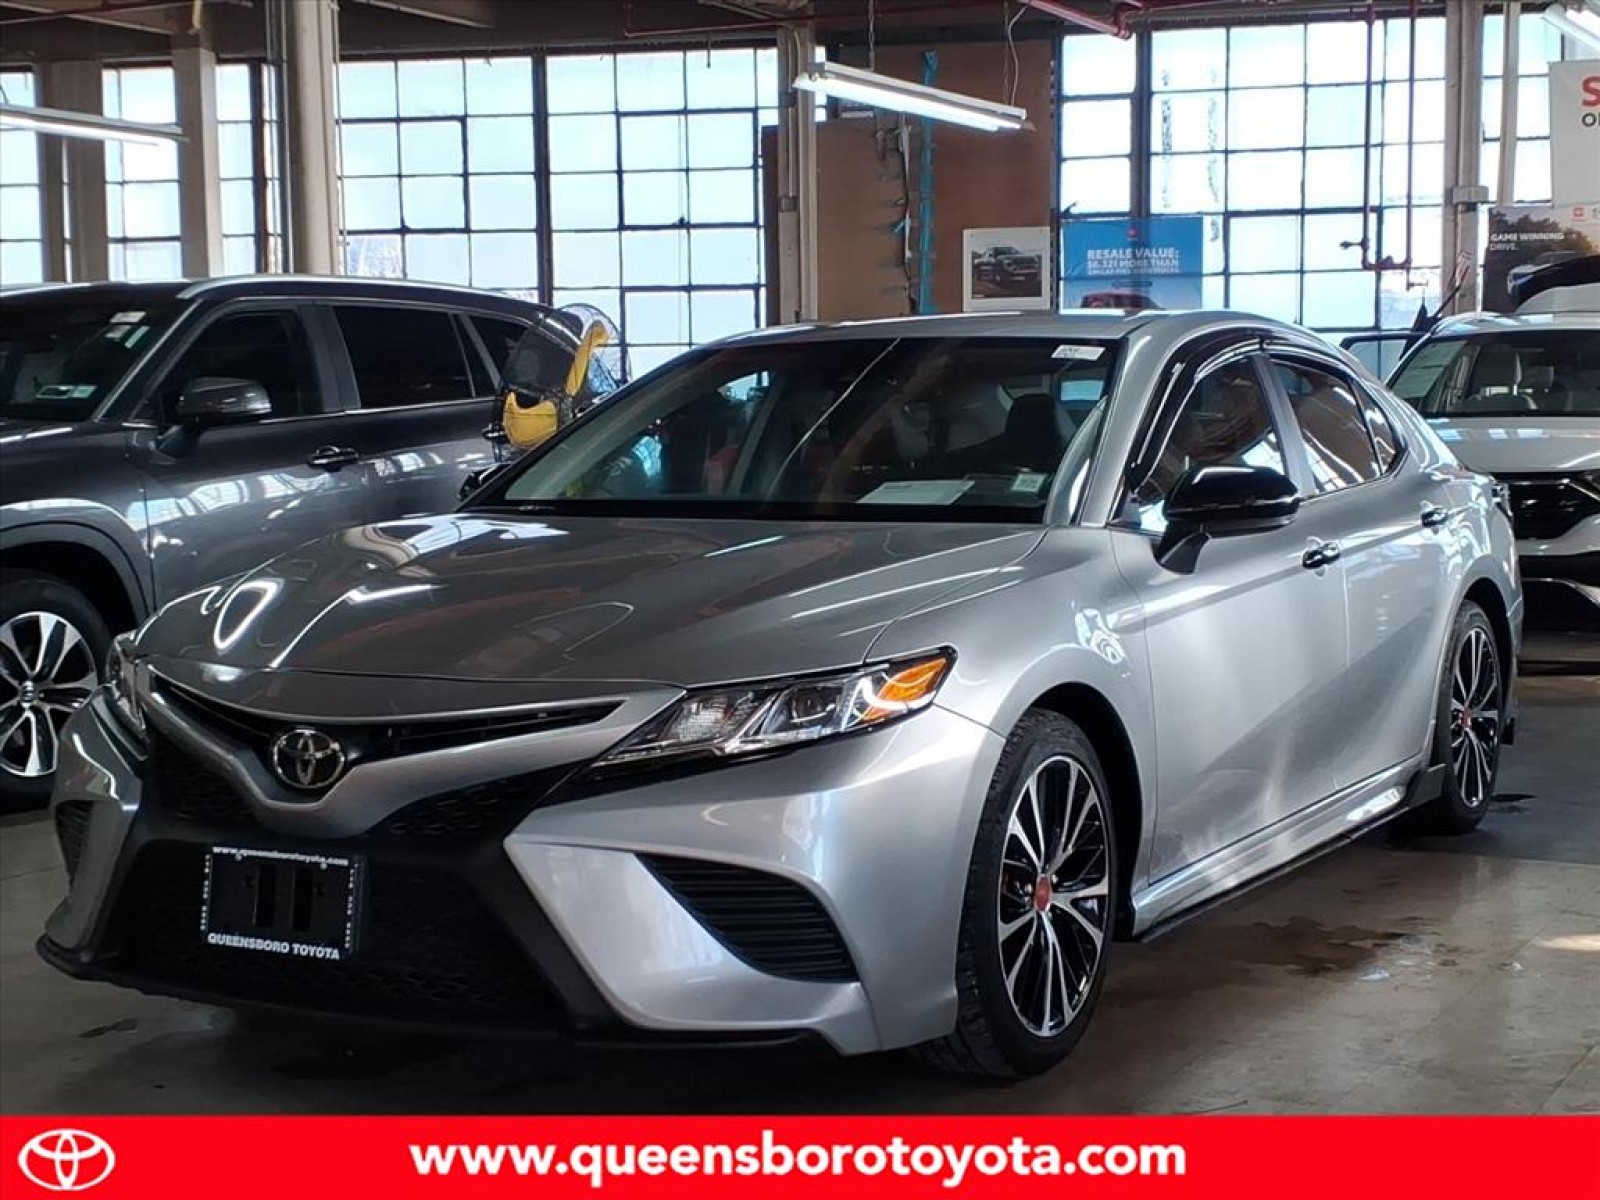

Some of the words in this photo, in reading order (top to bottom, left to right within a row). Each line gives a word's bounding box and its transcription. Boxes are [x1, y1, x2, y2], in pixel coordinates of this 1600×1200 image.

[1490, 233, 1518, 241] GAME
[1520, 232, 1565, 241] WINNING
[1087, 249, 1133, 259] RESALE
[1135, 247, 1179, 259] VALUE:
[1119, 259, 1149, 268] MORE
[1150, 258, 1179, 267] THAN
[207, 933, 290, 954] QUEENSBORO
[292, 943, 341, 960] TOYOTA
